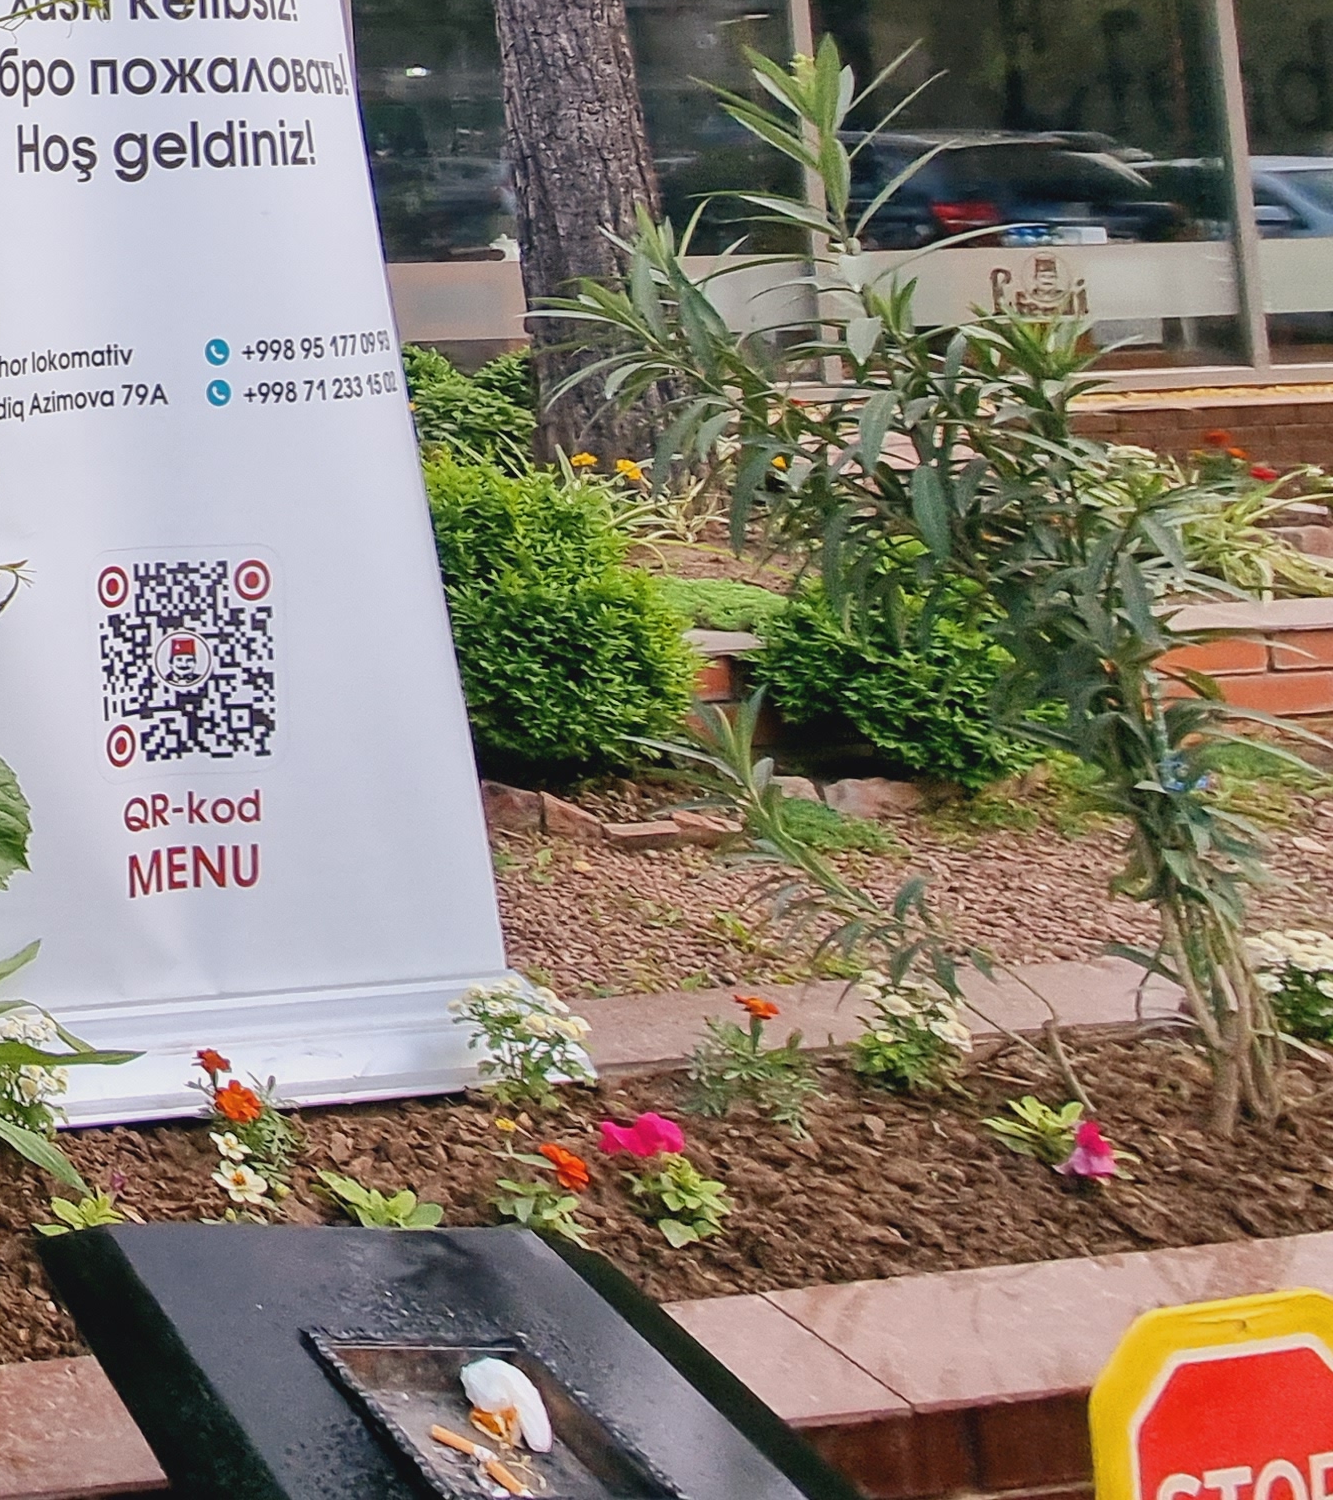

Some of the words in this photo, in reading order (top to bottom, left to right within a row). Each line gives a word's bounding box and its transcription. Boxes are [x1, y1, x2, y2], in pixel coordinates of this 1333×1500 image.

[90, 52, 350, 96] пожаловать!
[16, 124, 98, 183] Hoş
[113, 118, 316, 183] geldiniz!
[32, 344, 133, 373] lokomativ
[242, 339, 295, 362] +998
[300, 337, 325, 359] 95
[330, 334, 357, 357] 177
[29, 391, 115, 415] Azimova
[121, 384, 169, 406] 79A
[243, 381, 298, 404] +998
[303, 379, 327, 401] 71
[332, 376, 363, 399] 233
[366, 373, 382, 395] 15
[123, 788, 262, 832] QR-kod
[128, 843, 260, 899] MENU
